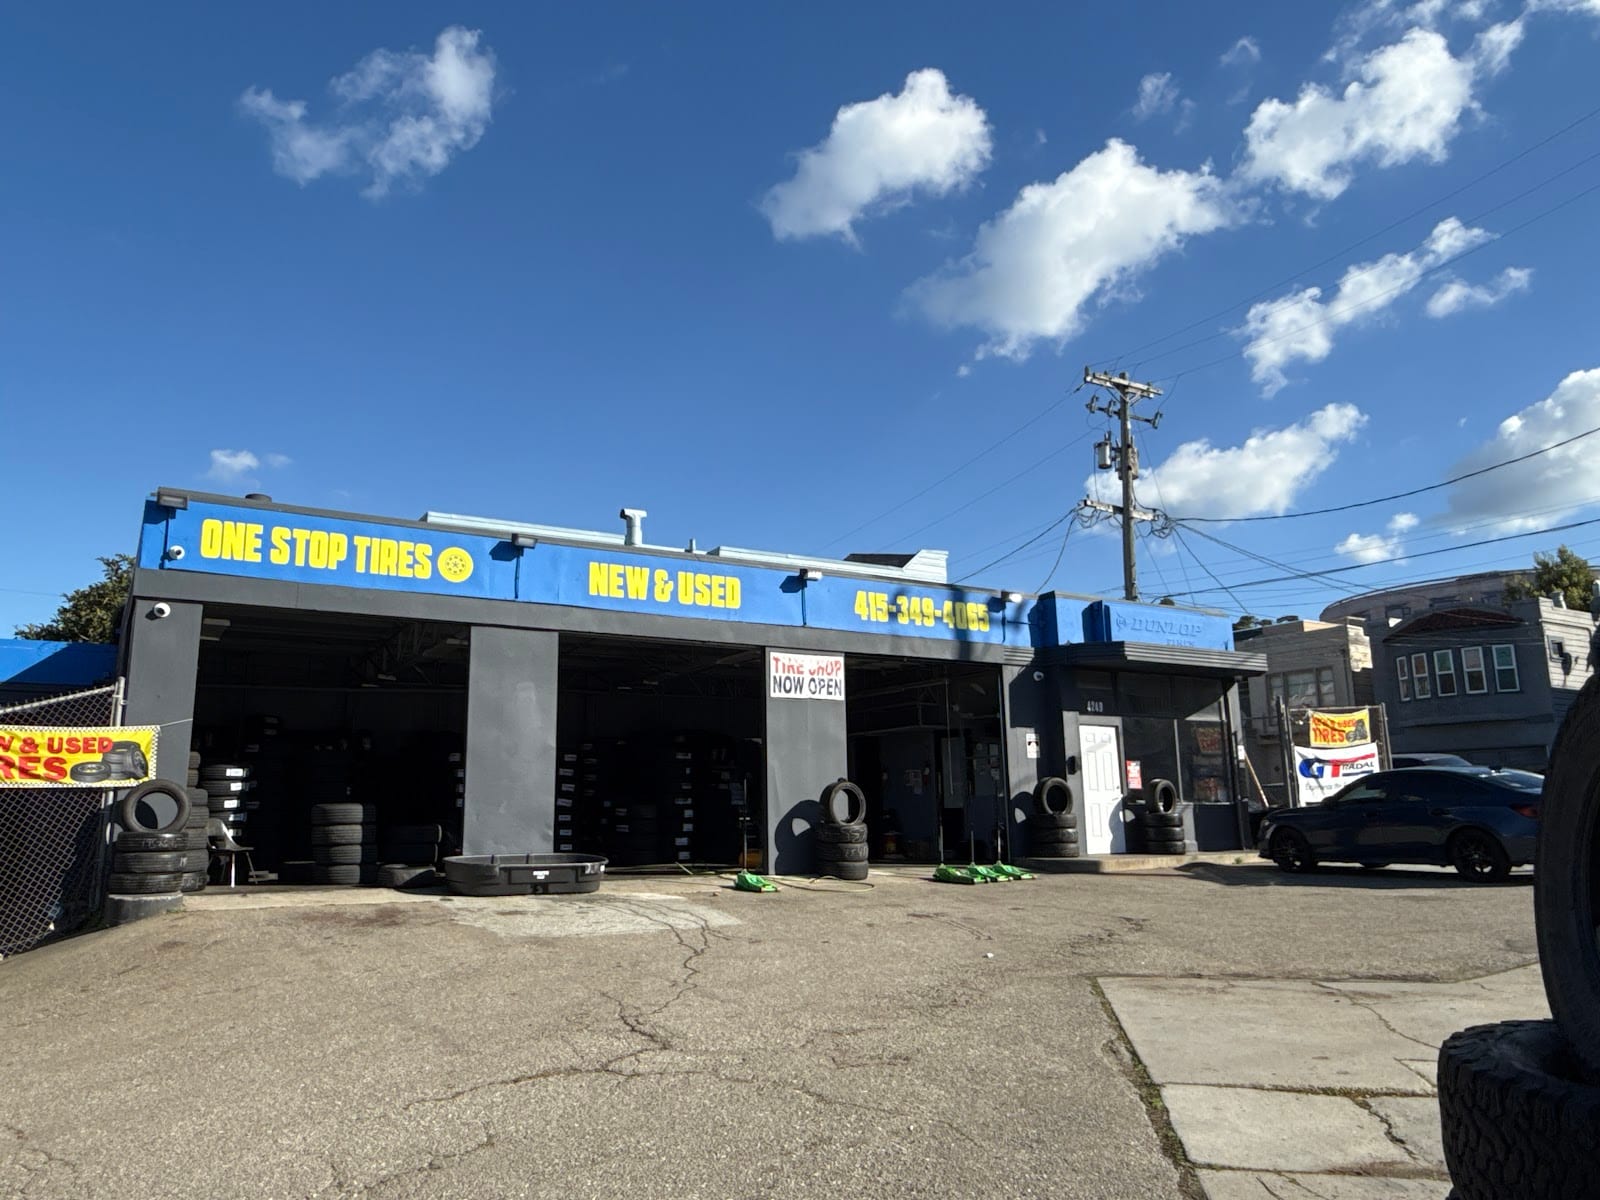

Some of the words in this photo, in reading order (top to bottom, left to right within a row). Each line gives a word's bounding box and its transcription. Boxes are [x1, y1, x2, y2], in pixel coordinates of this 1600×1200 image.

[200, 518, 264, 562] ONE
[270, 526, 348, 570] STOP
[353, 535, 432, 580] TIRES
[588, 561, 650, 600] NEW
[654, 569, 674, 602] &
[678, 571, 741, 609] USED
[854, 590, 990, 632] 415-349-4065
[773, 675, 804, 694] NOW
[808, 677, 842, 696] OPEN
[19, 737, 39, 754] &
[47, 737, 113, 753] USED
[1299, 757, 1341, 778] GT
[1342, 761, 1375, 771] RADAL
